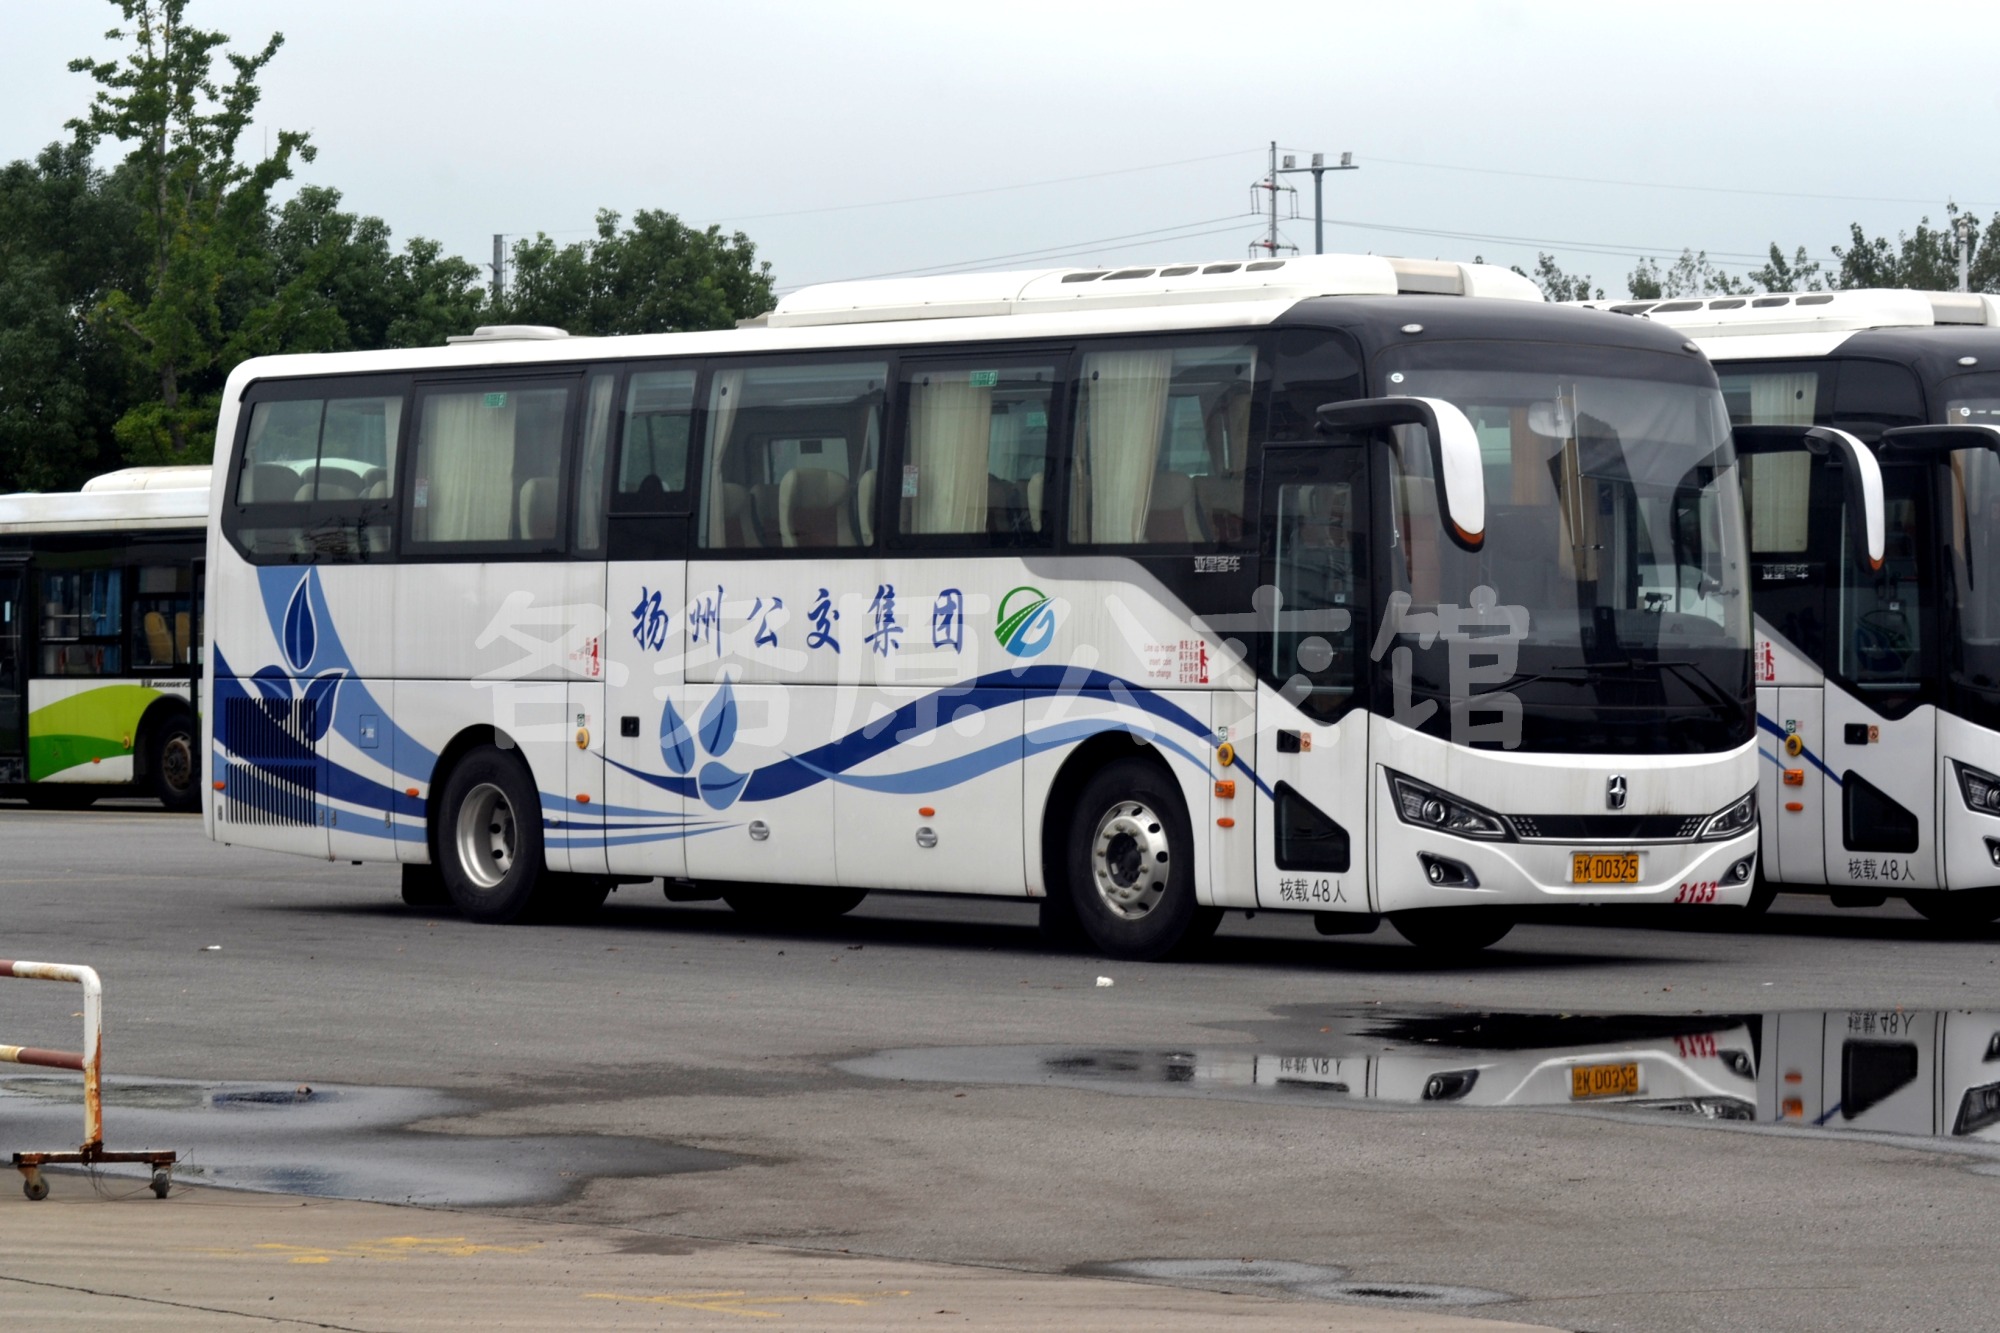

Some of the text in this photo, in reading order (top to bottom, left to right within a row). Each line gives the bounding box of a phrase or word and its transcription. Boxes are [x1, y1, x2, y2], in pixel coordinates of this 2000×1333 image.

[1194, 555, 1241, 573] 亚星客车
[631, 584, 964, 657] 扬州公交集团
[1848, 858, 1916, 881] 核载48人
[1280, 878, 1347, 903] 核载48人
[1674, 881, 1719, 904] 3133
